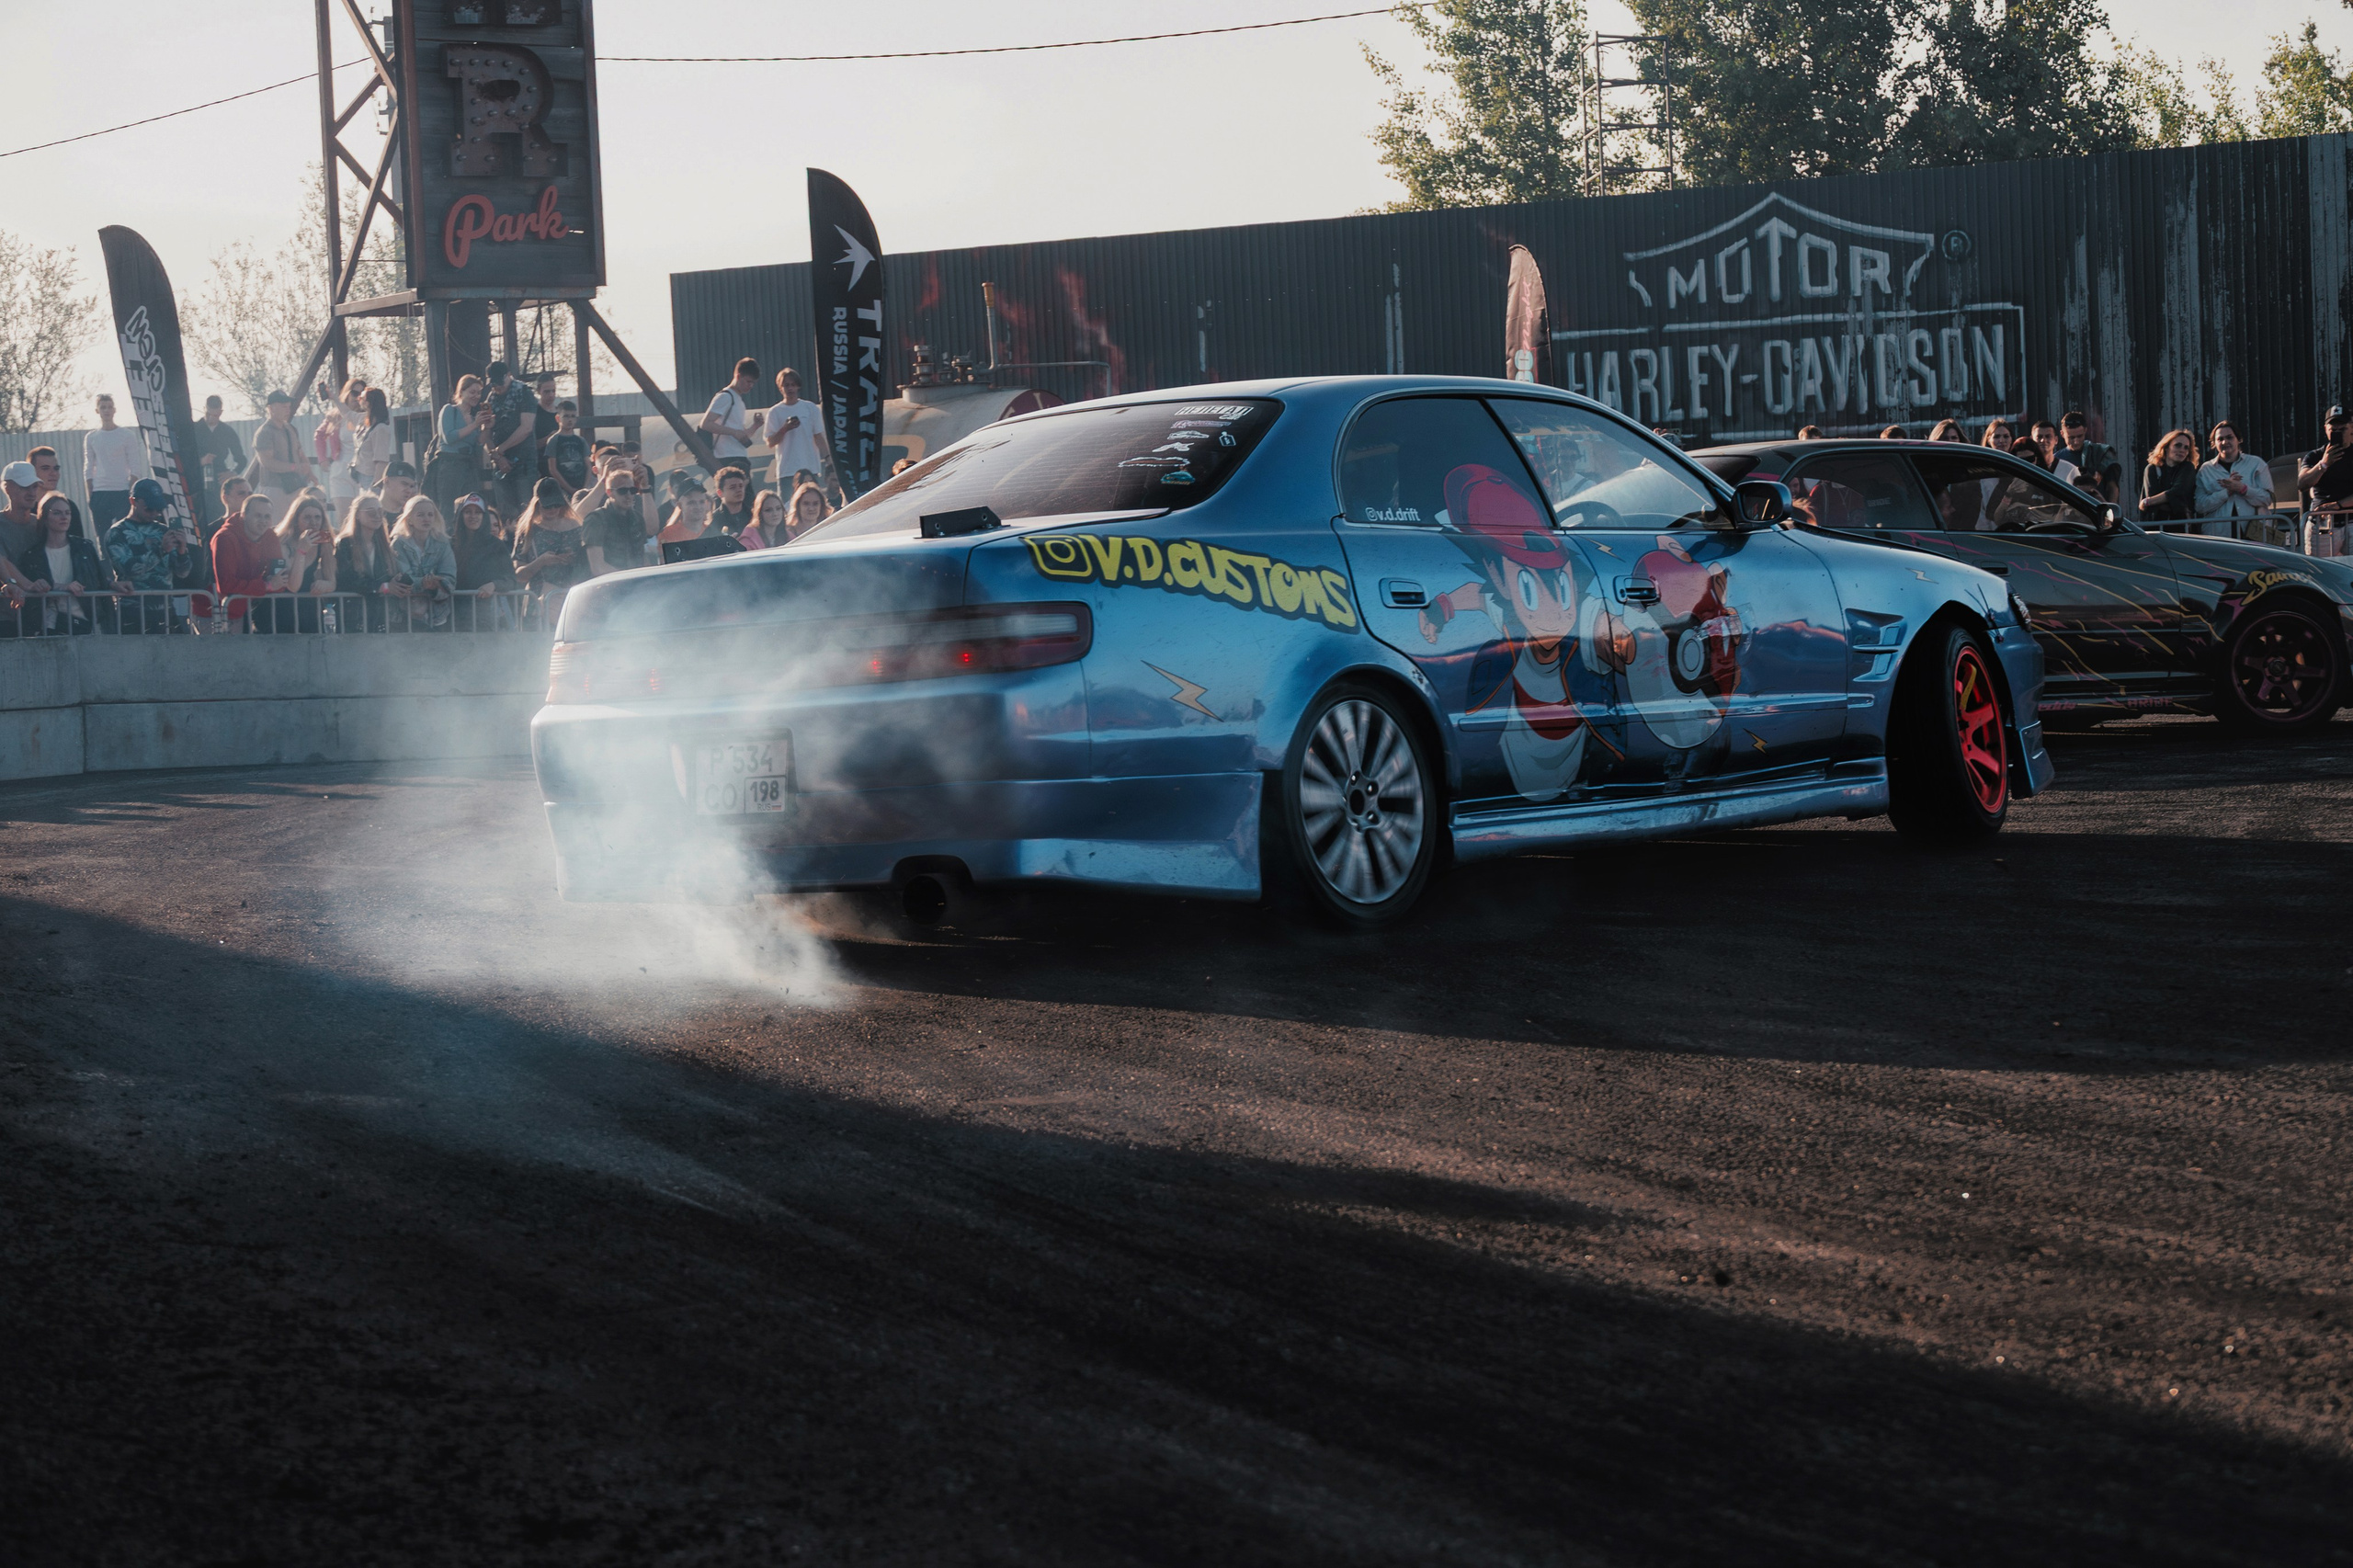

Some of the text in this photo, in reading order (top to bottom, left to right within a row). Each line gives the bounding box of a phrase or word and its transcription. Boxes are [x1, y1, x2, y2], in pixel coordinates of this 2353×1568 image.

[445, 185, 569, 268] Park
[1667, 216, 1892, 310] MOTOR
[833, 306, 848, 375] RUSSIA
[832, 394, 847, 453] JAPAN
[1079, 534, 1358, 628] V.D.CUSTOMS
[750, 779, 779, 802] 198
[757, 803, 771, 812] RUS
